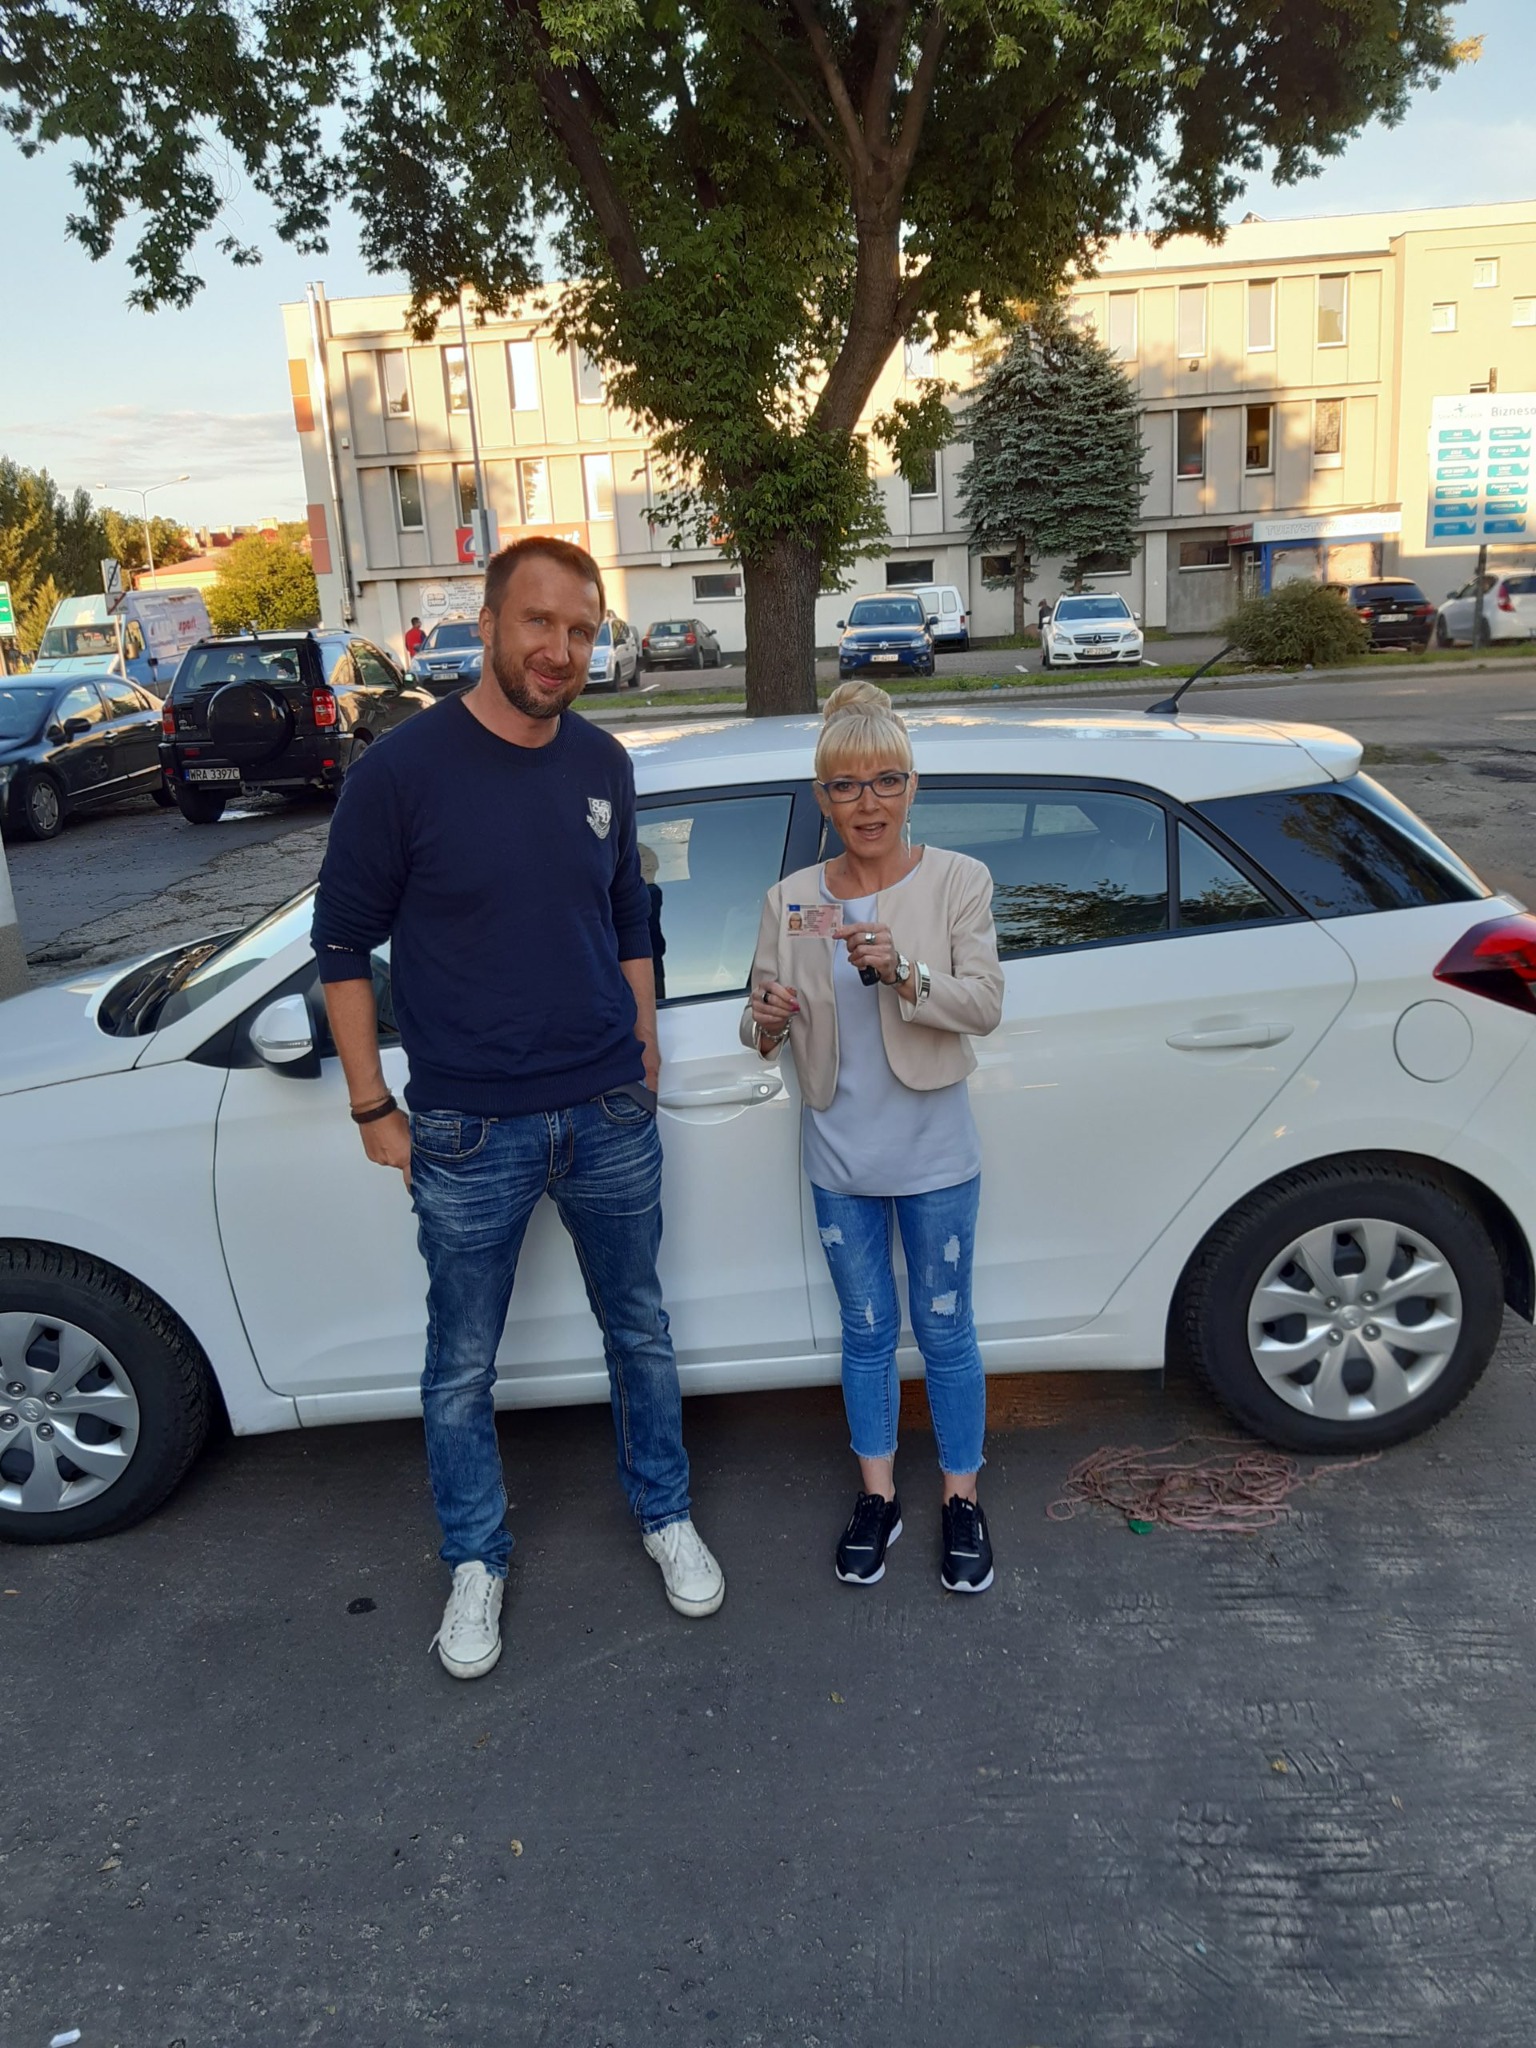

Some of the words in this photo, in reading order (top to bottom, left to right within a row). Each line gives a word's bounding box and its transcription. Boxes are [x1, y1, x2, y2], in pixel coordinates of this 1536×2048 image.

[1266, 519, 1344, 536] TURYSTYKA
[190, 769, 208, 780] WRA
[210, 768, 239, 780] 3397C
